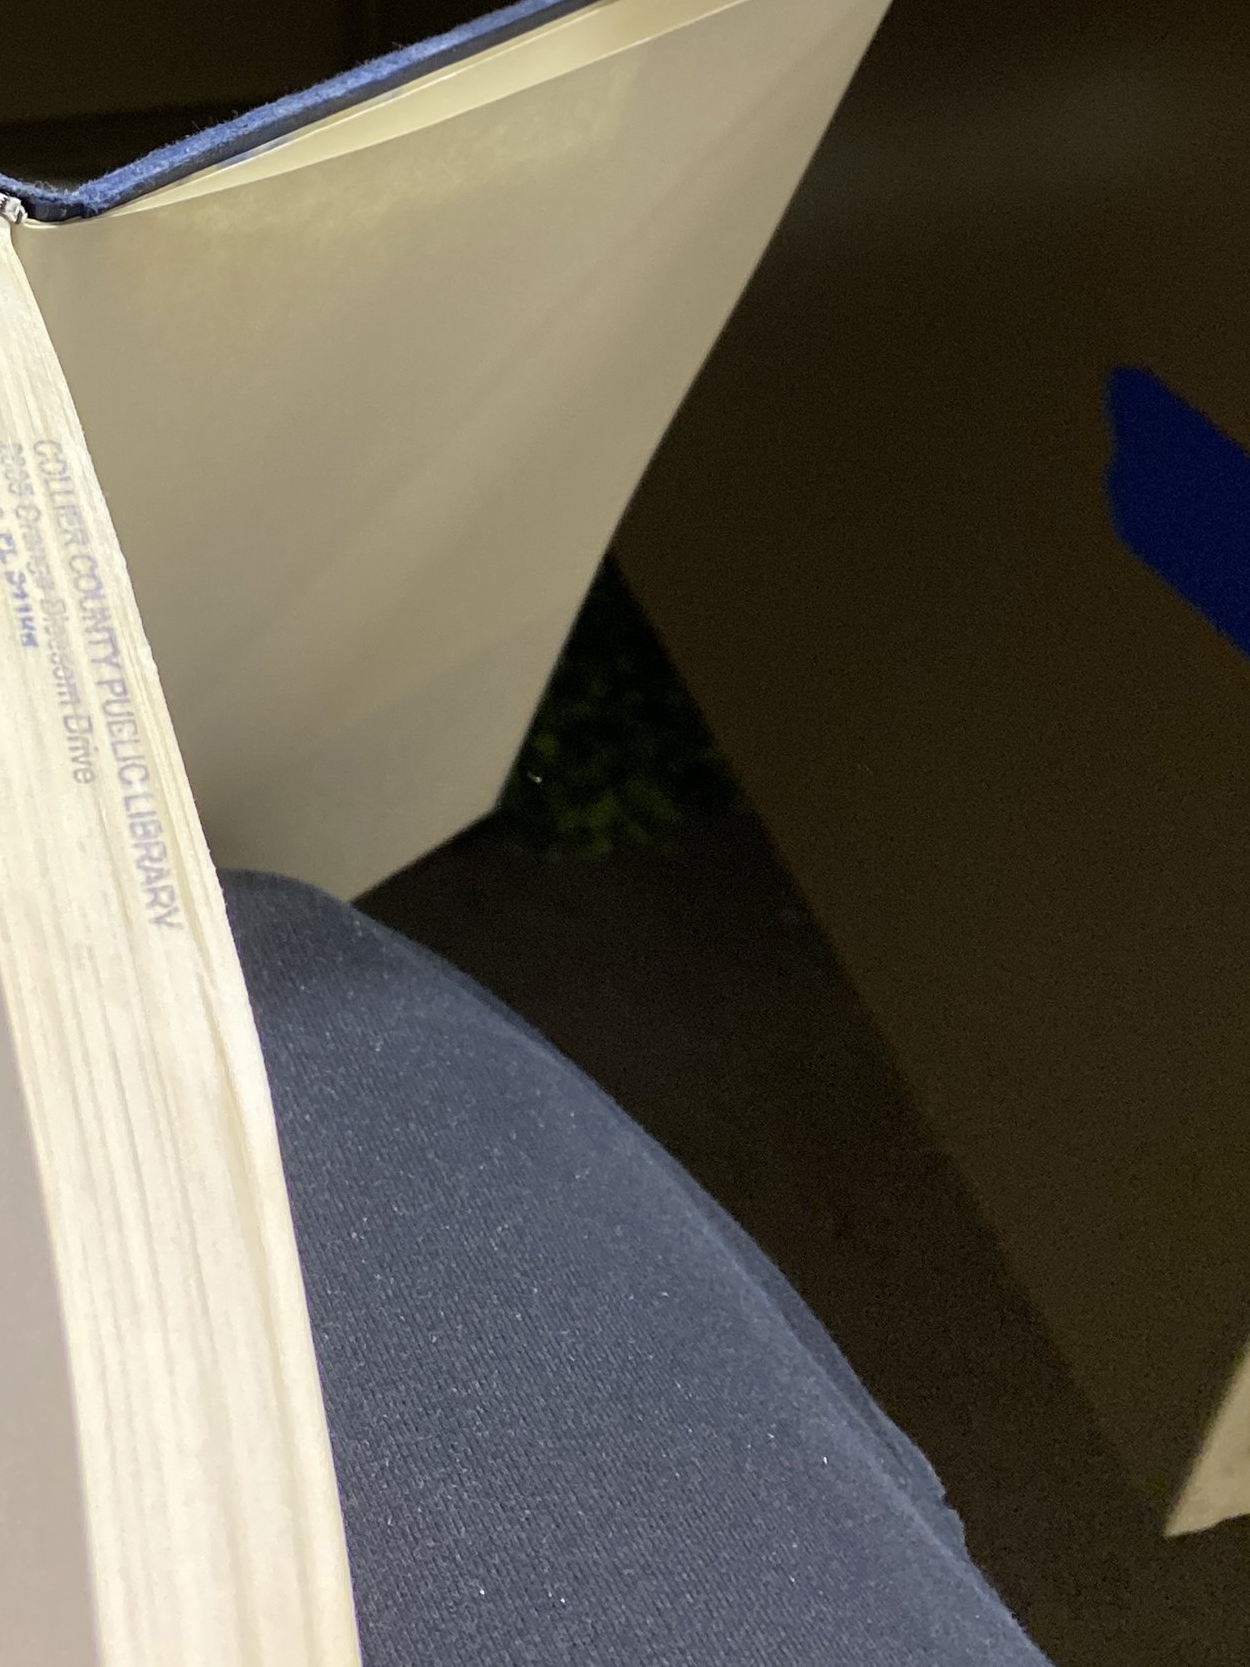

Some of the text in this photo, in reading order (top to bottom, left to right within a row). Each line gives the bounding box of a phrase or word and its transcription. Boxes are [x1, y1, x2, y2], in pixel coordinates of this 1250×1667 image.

[33, 440, 184, 932] COLLIER COUNTY PUBLIC LIBRARY
[63, 714, 98, 784] Drive
